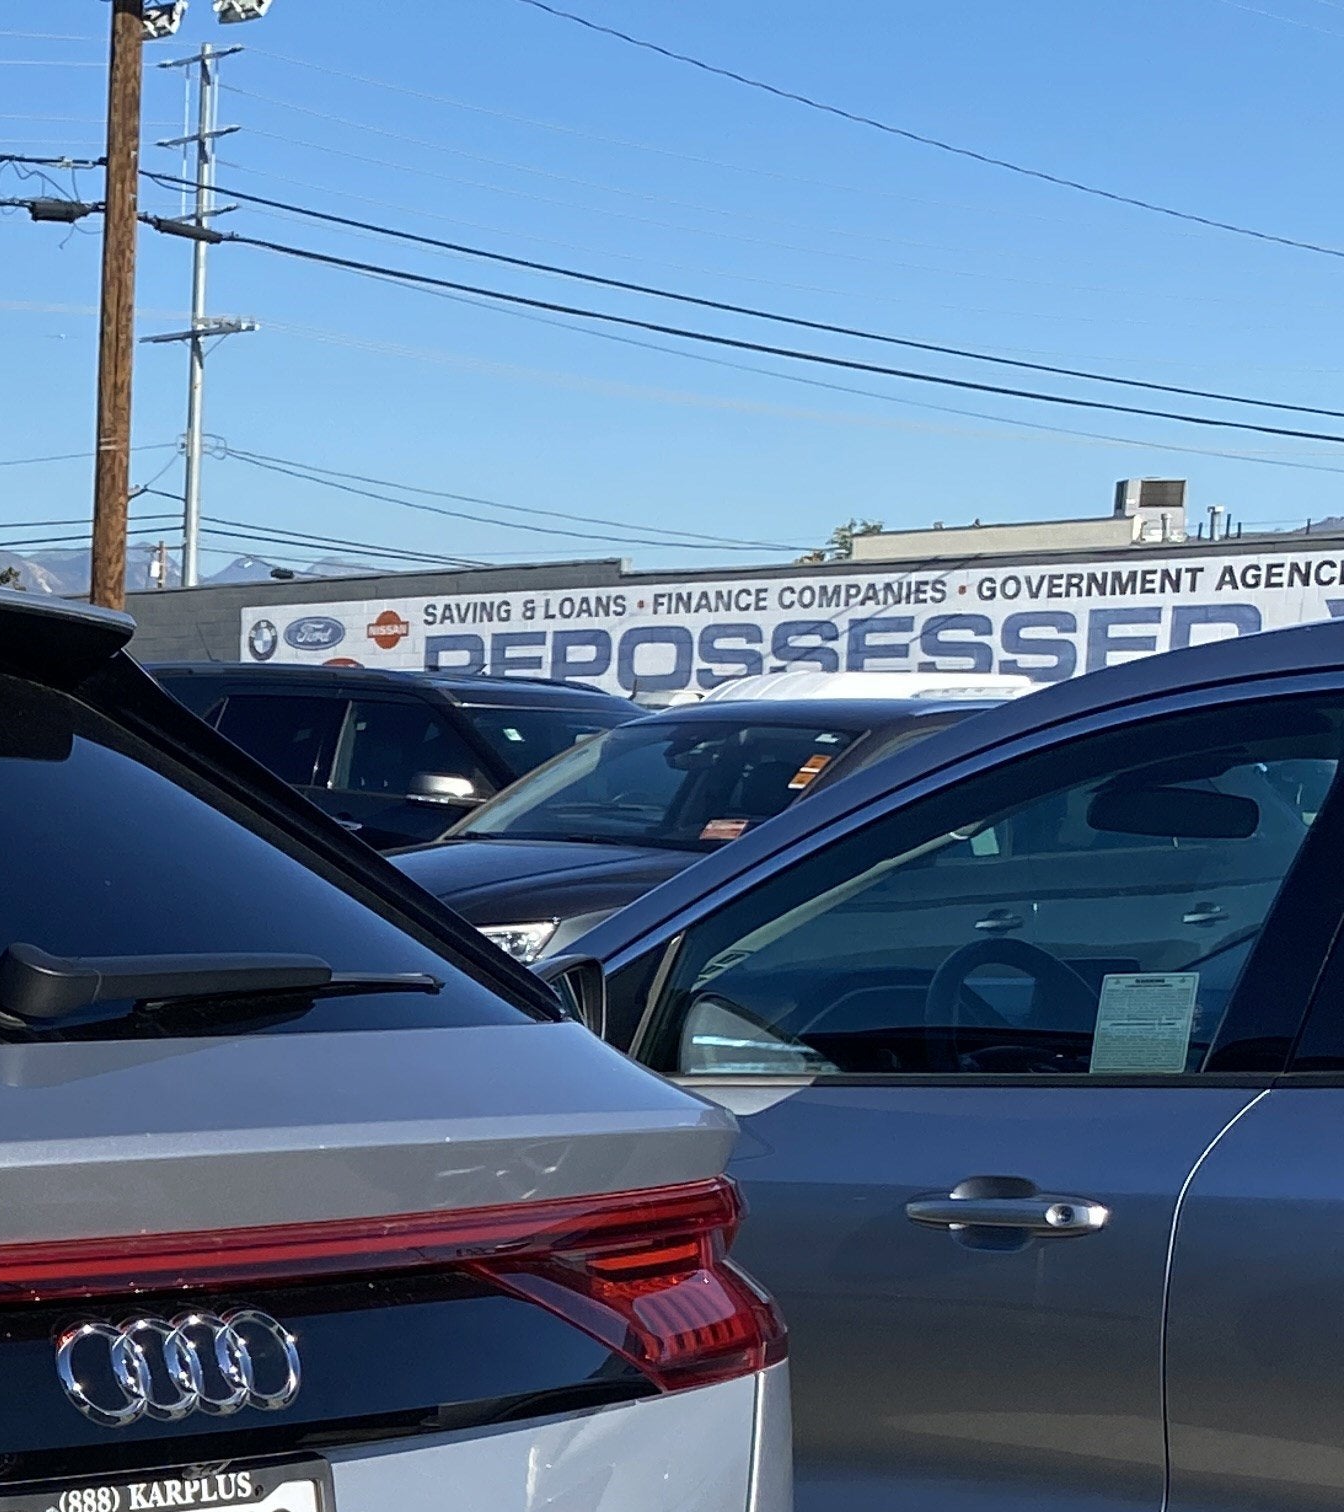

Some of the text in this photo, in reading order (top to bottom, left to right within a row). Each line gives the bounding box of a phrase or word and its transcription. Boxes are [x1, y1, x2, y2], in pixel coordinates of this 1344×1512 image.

[422, 599, 511, 625] SAVING
[521, 599, 535, 620] &
[543, 595, 627, 620] LOANS
[652, 587, 768, 615] FINANCE
[777, 579, 948, 609] COMPANIES
[976, 566, 1204, 601] GOVERNMENT
[368, 624, 408, 636] NISSAN
[128, 1472, 252, 1511] KARPLUS
